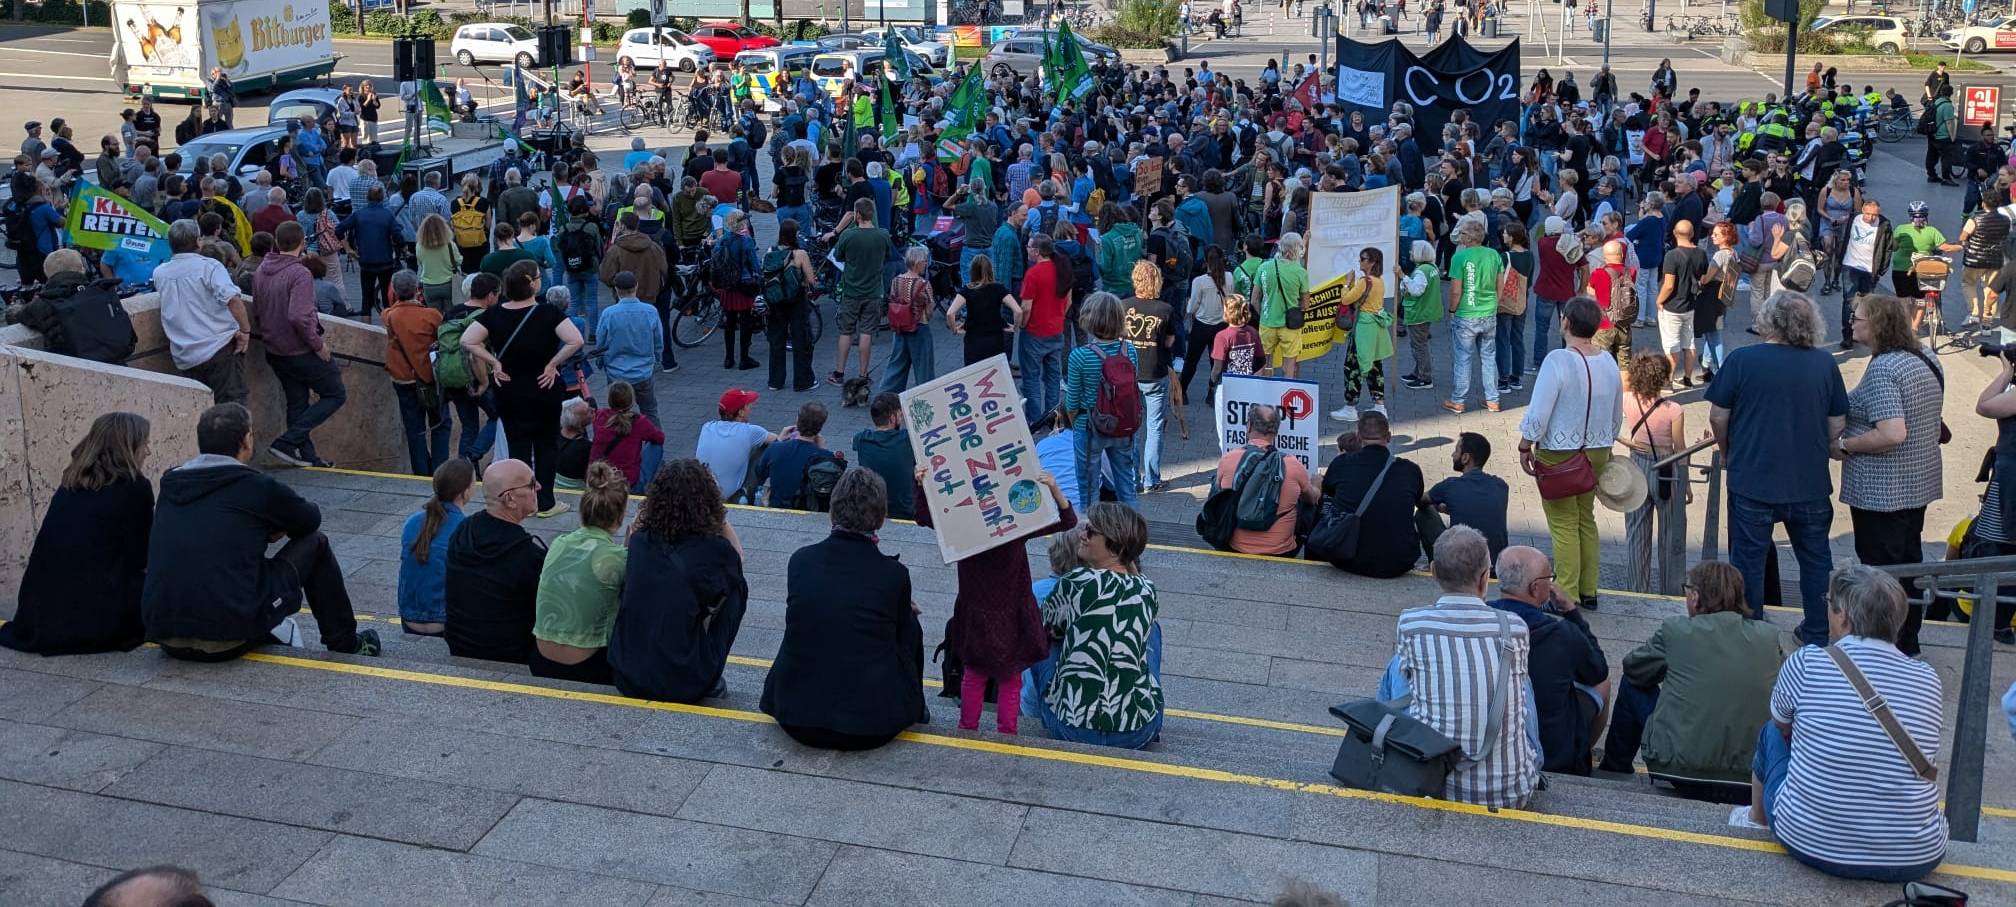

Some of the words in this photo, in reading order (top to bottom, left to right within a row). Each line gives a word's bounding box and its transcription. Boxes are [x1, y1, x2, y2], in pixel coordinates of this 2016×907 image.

[251, 17, 325, 52] Bitburger
[1309, 288, 1341, 307] SCHUTZ
[974, 368, 1015, 434] Weil
[996, 439, 1027, 477] ihr
[944, 382, 984, 452] meine
[965, 451, 1018, 538] Zukunft
